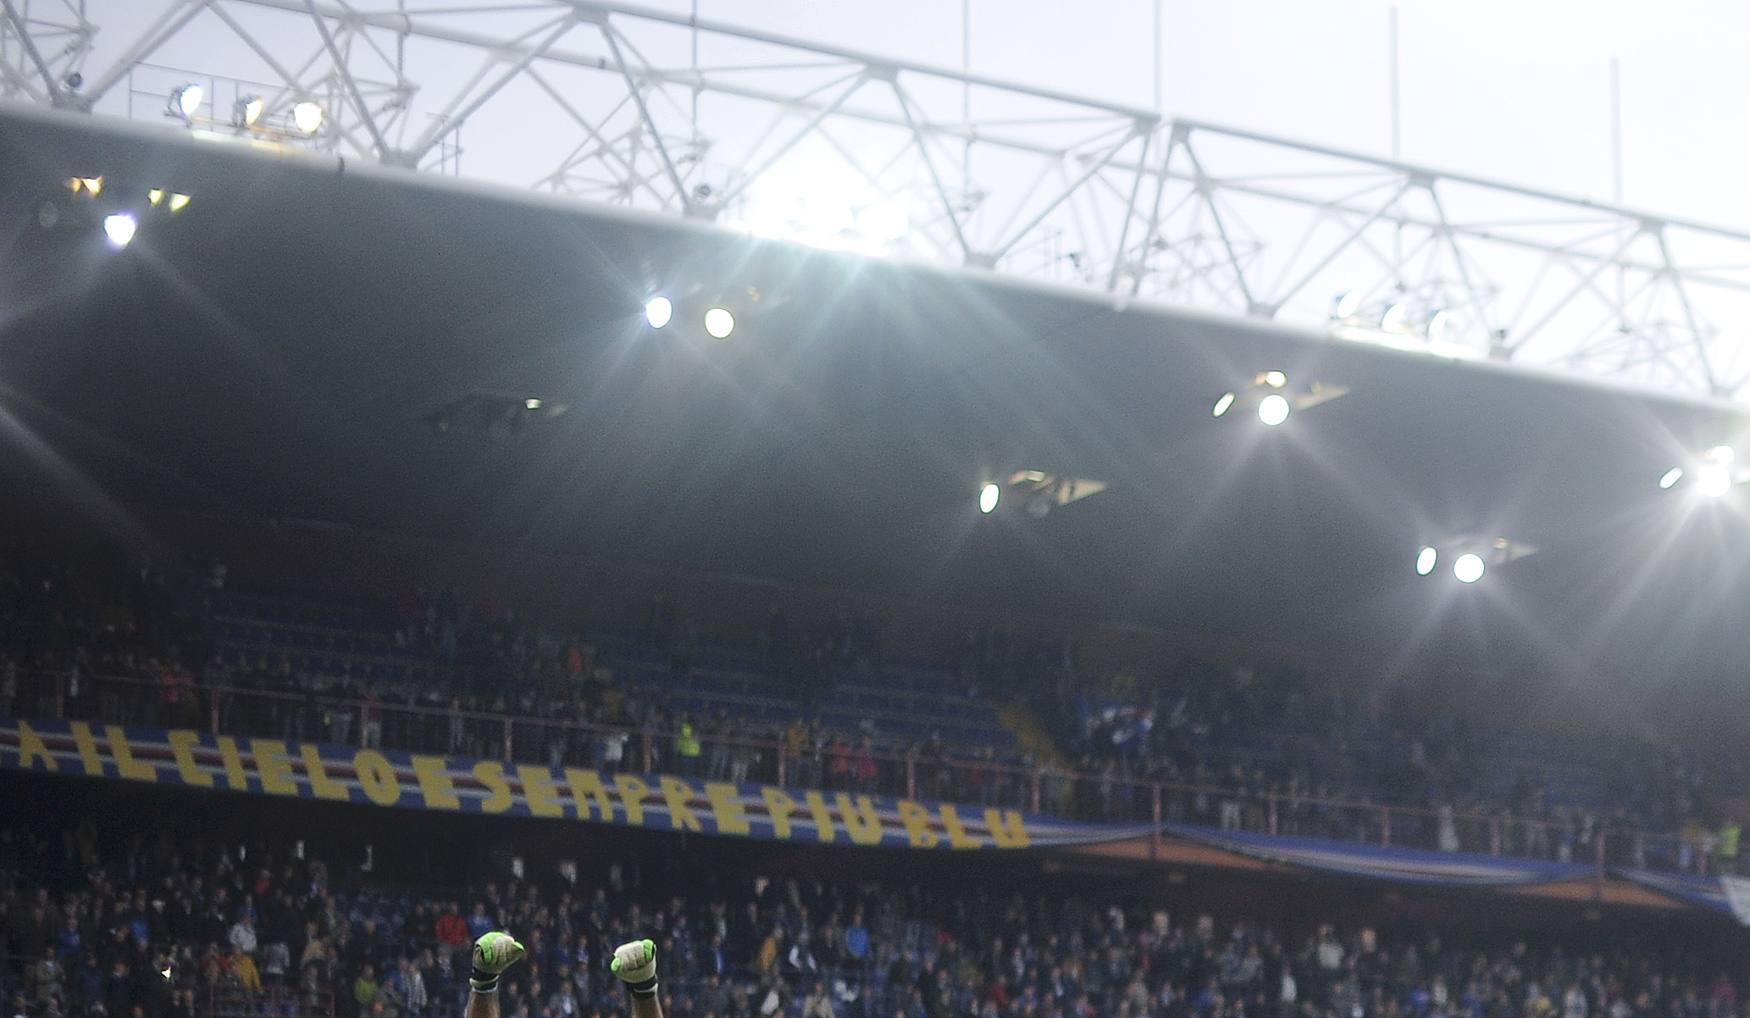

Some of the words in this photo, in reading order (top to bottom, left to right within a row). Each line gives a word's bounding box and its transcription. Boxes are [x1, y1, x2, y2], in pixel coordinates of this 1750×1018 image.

[70, 721, 157, 781] IL
[167, 729, 402, 807] CIELO
[471, 761, 750, 836] SEMPRE
[898, 800, 1031, 849] BLU
